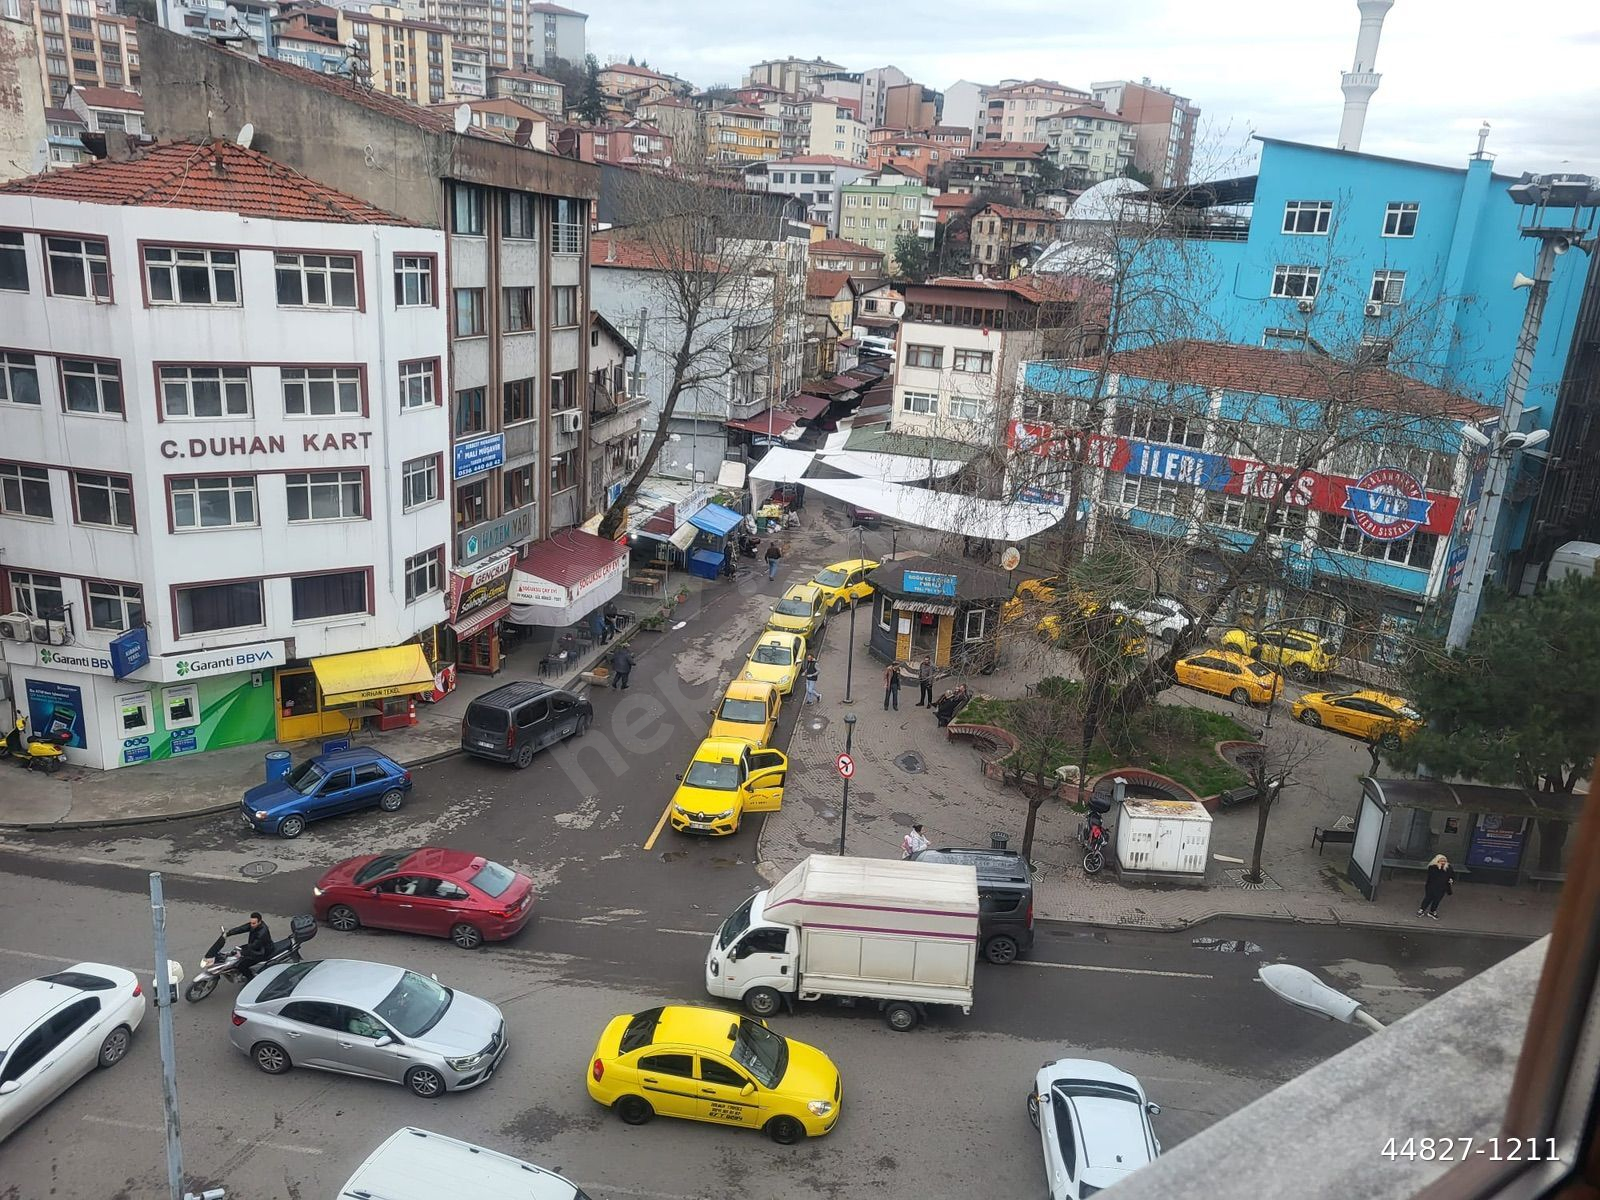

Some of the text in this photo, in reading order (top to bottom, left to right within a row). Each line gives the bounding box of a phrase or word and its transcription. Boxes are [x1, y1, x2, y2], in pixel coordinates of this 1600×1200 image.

[160, 431, 373, 459] C.DUHAN KART
[511, 513, 531, 537] YAPI
[52, 652, 114, 670] Garanti BBV
[190, 650, 273, 672] Garanti BBVA
[360, 687, 400, 698] KIRHAN TEKEL
